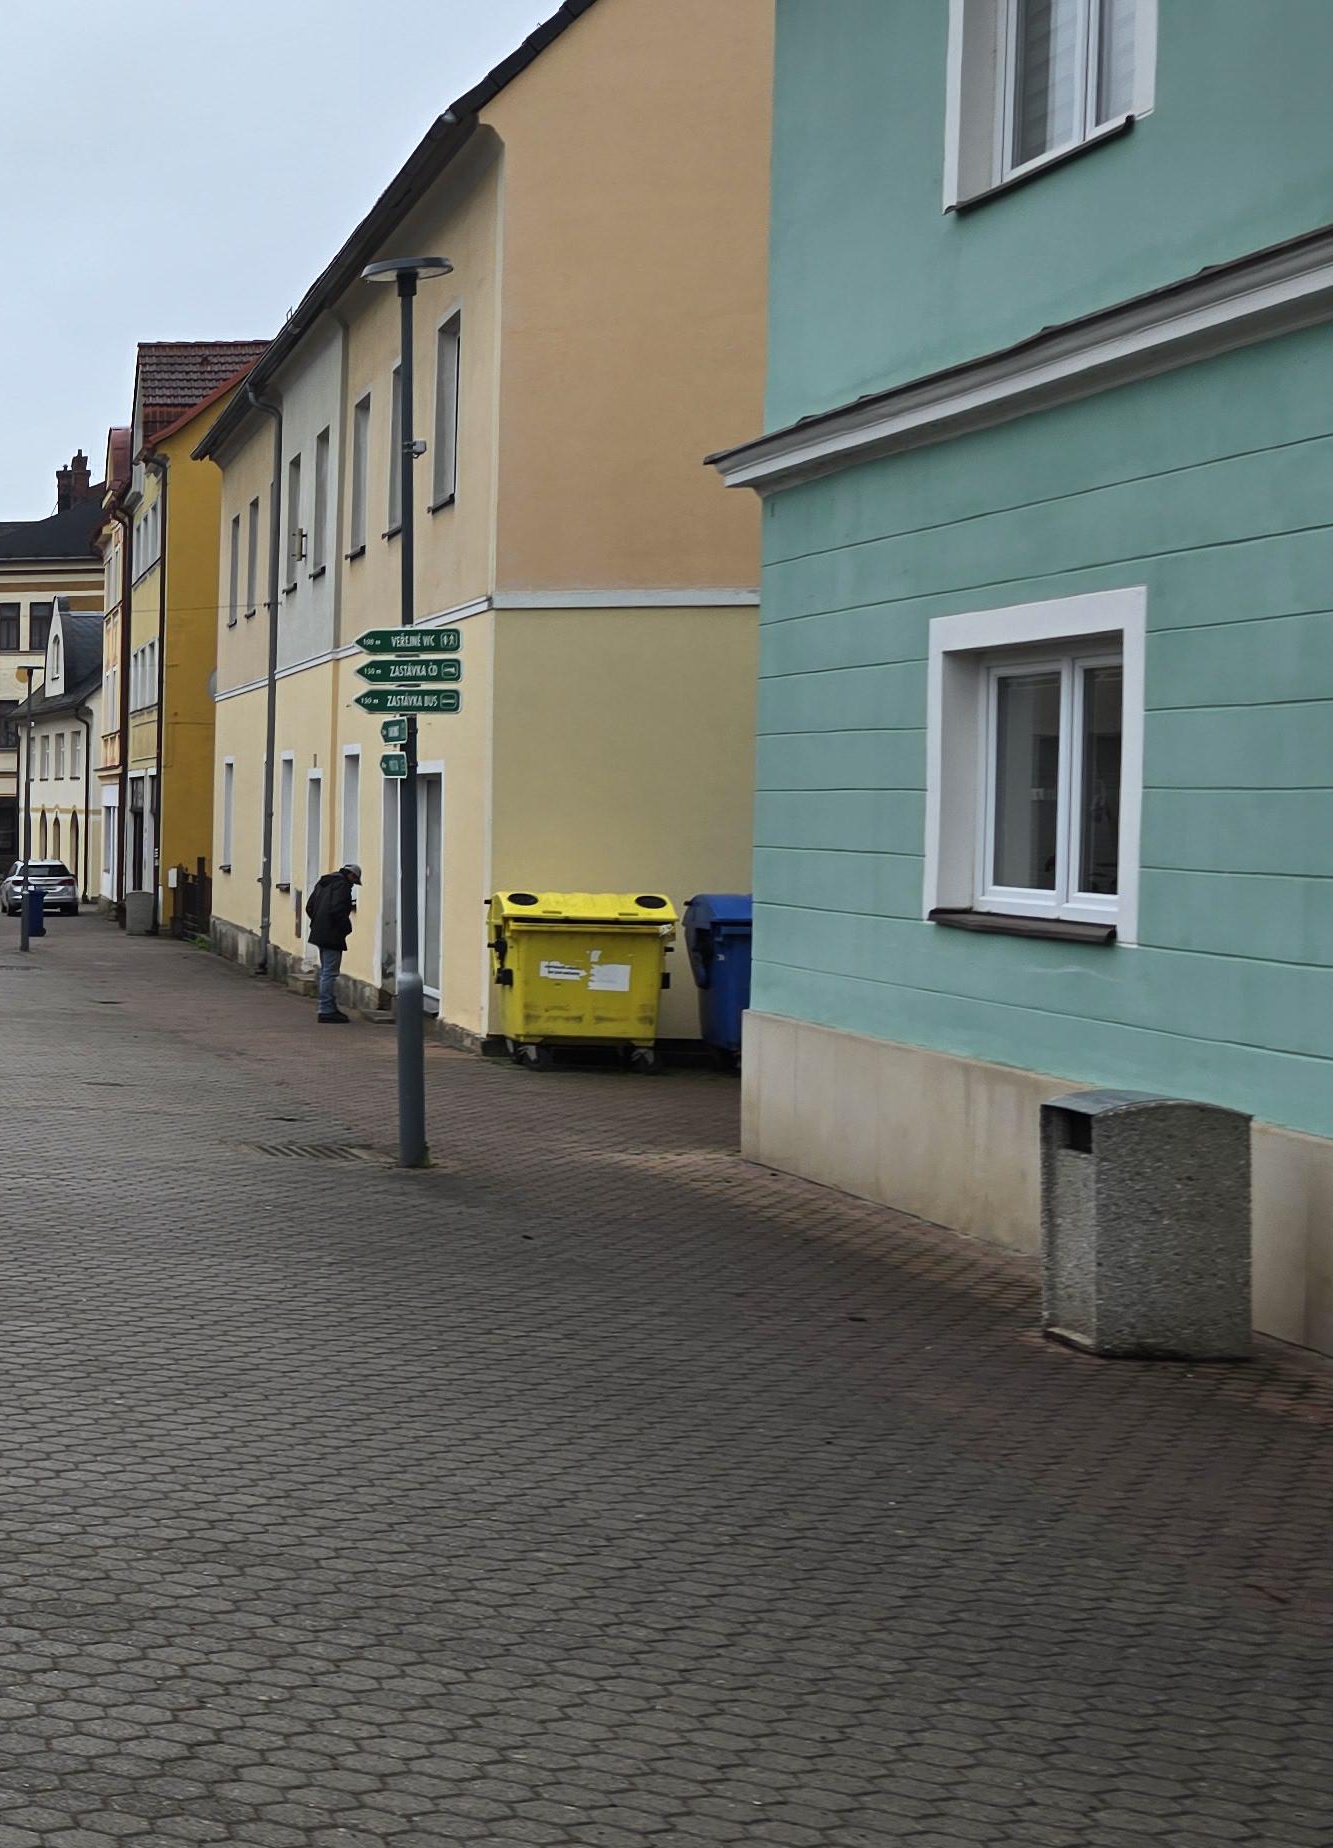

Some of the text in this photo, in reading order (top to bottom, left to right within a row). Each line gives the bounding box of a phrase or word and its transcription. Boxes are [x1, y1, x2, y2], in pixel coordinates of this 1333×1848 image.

[391, 633, 421, 647] VEŘEJNÉ
[423, 634, 435, 647] WC
[390, 662, 426, 677] ZASTÁVKA
[428, 661, 438, 676] ČD
[386, 692, 423, 707] ZASTÁVKA
[423, 695, 438, 707] BUS
